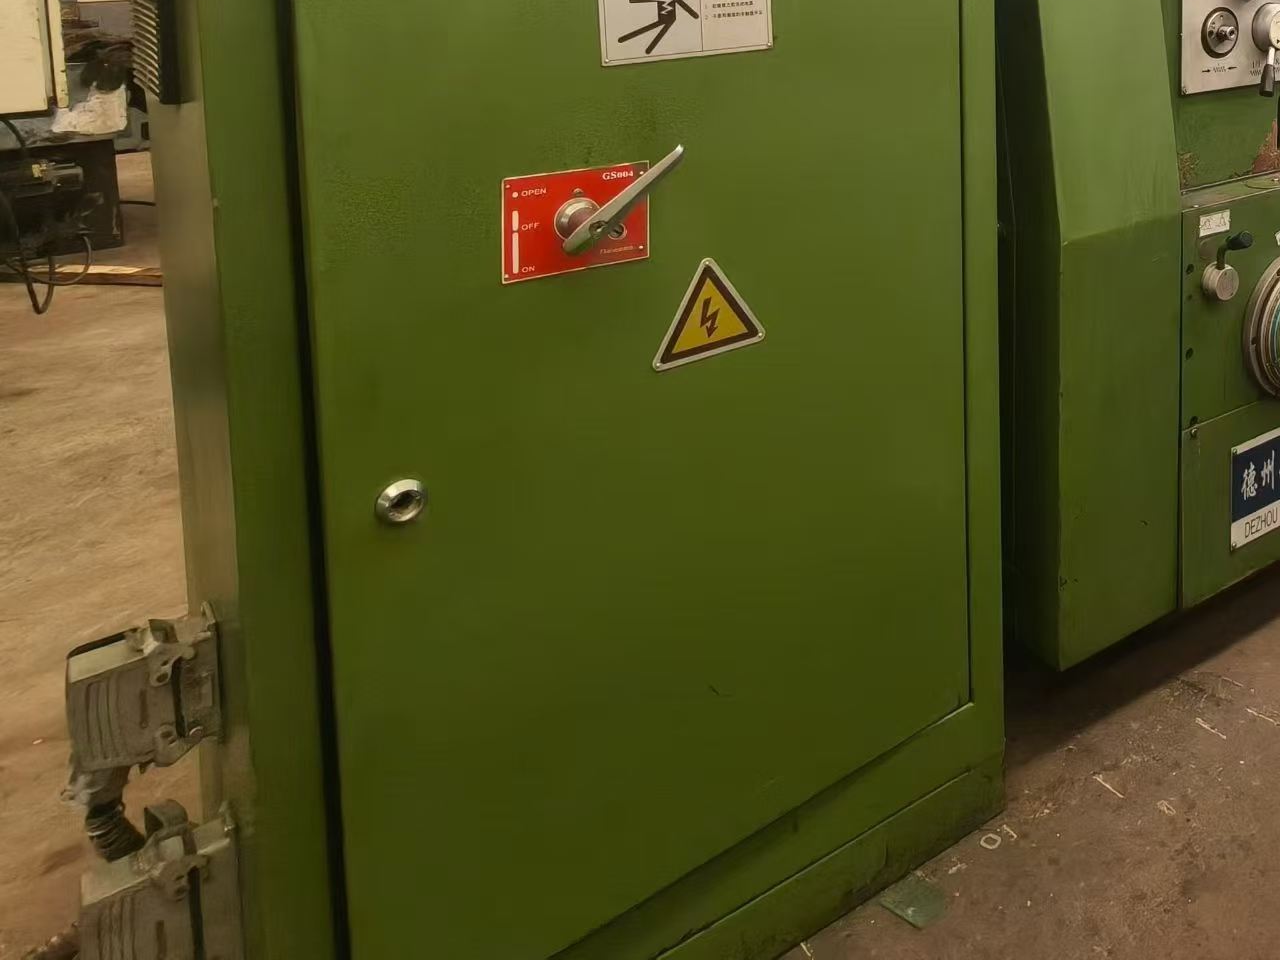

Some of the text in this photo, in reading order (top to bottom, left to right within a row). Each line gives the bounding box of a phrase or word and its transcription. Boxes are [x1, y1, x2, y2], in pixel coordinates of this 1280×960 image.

[602, 170, 634, 180] GS004
[521, 187, 547, 197] OPEN
[521, 222, 540, 231] OFF
[521, 265, 535, 273] ON
[1244, 507, 1278, 538] DEZHOU
